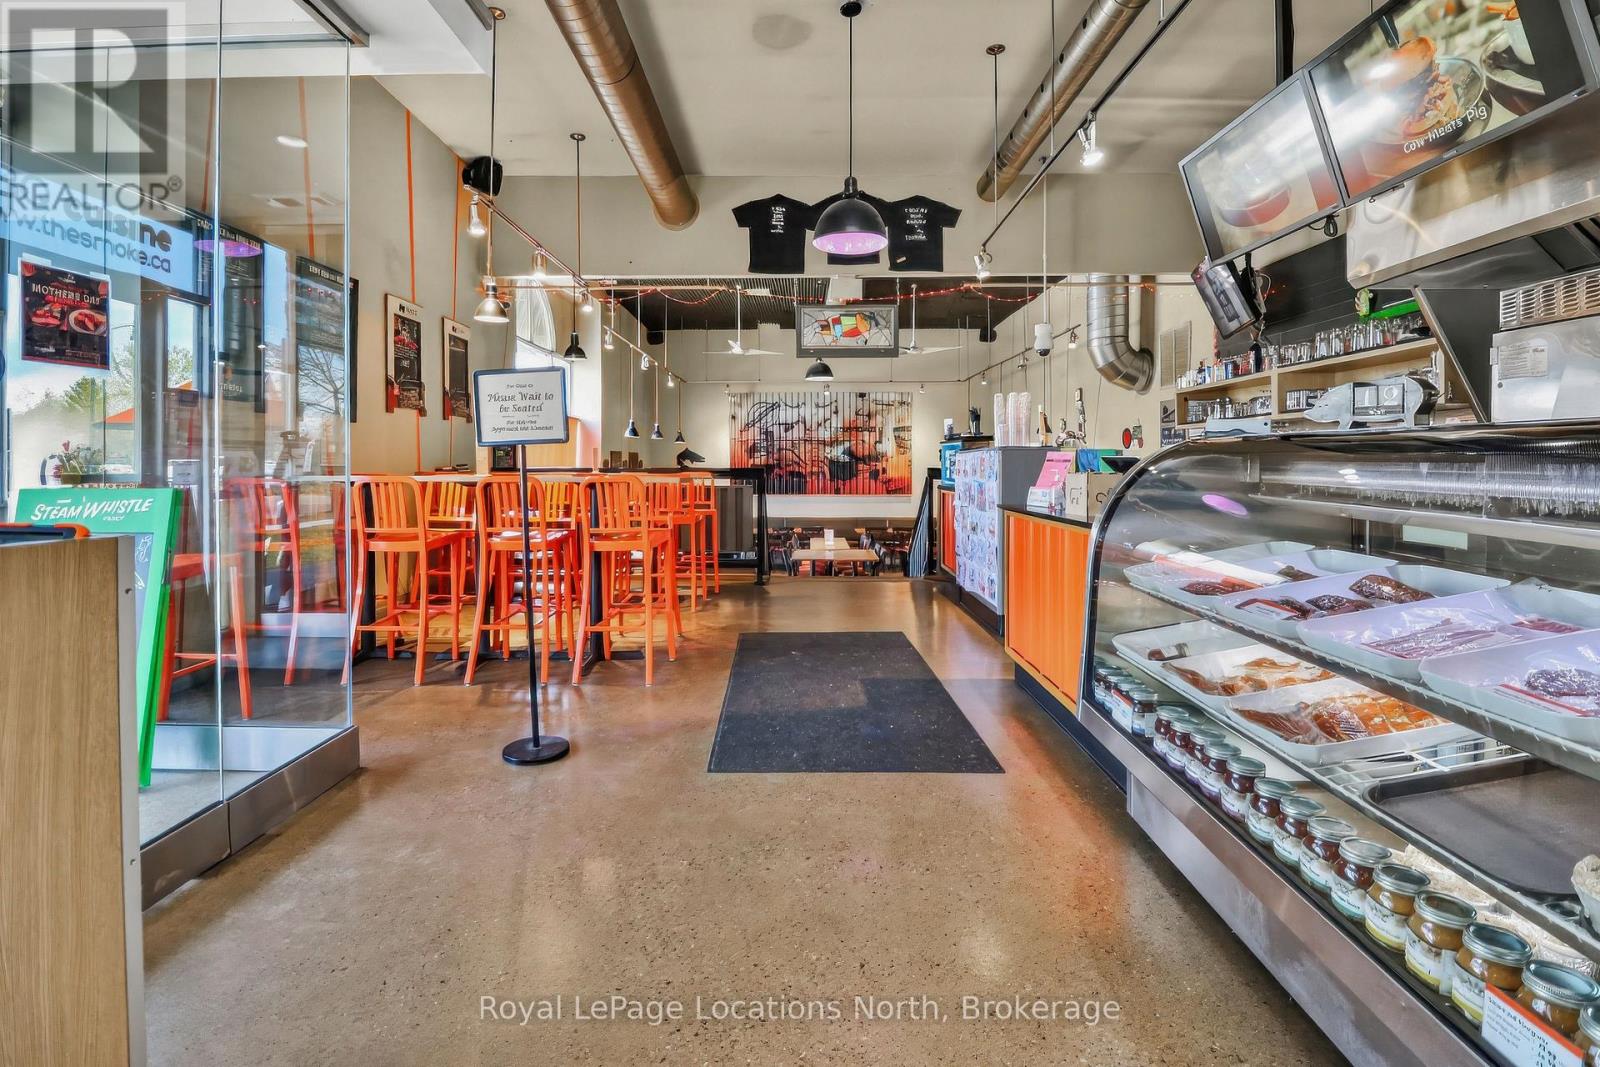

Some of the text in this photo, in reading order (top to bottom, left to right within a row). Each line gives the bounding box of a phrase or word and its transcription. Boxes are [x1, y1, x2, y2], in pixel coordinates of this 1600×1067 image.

[1466, 106, 1488, 122] Pig
[519, 391, 541, 401] Wait
[545, 392, 554, 400] to
[31, 497, 154, 520] STEAM WHISTLE
